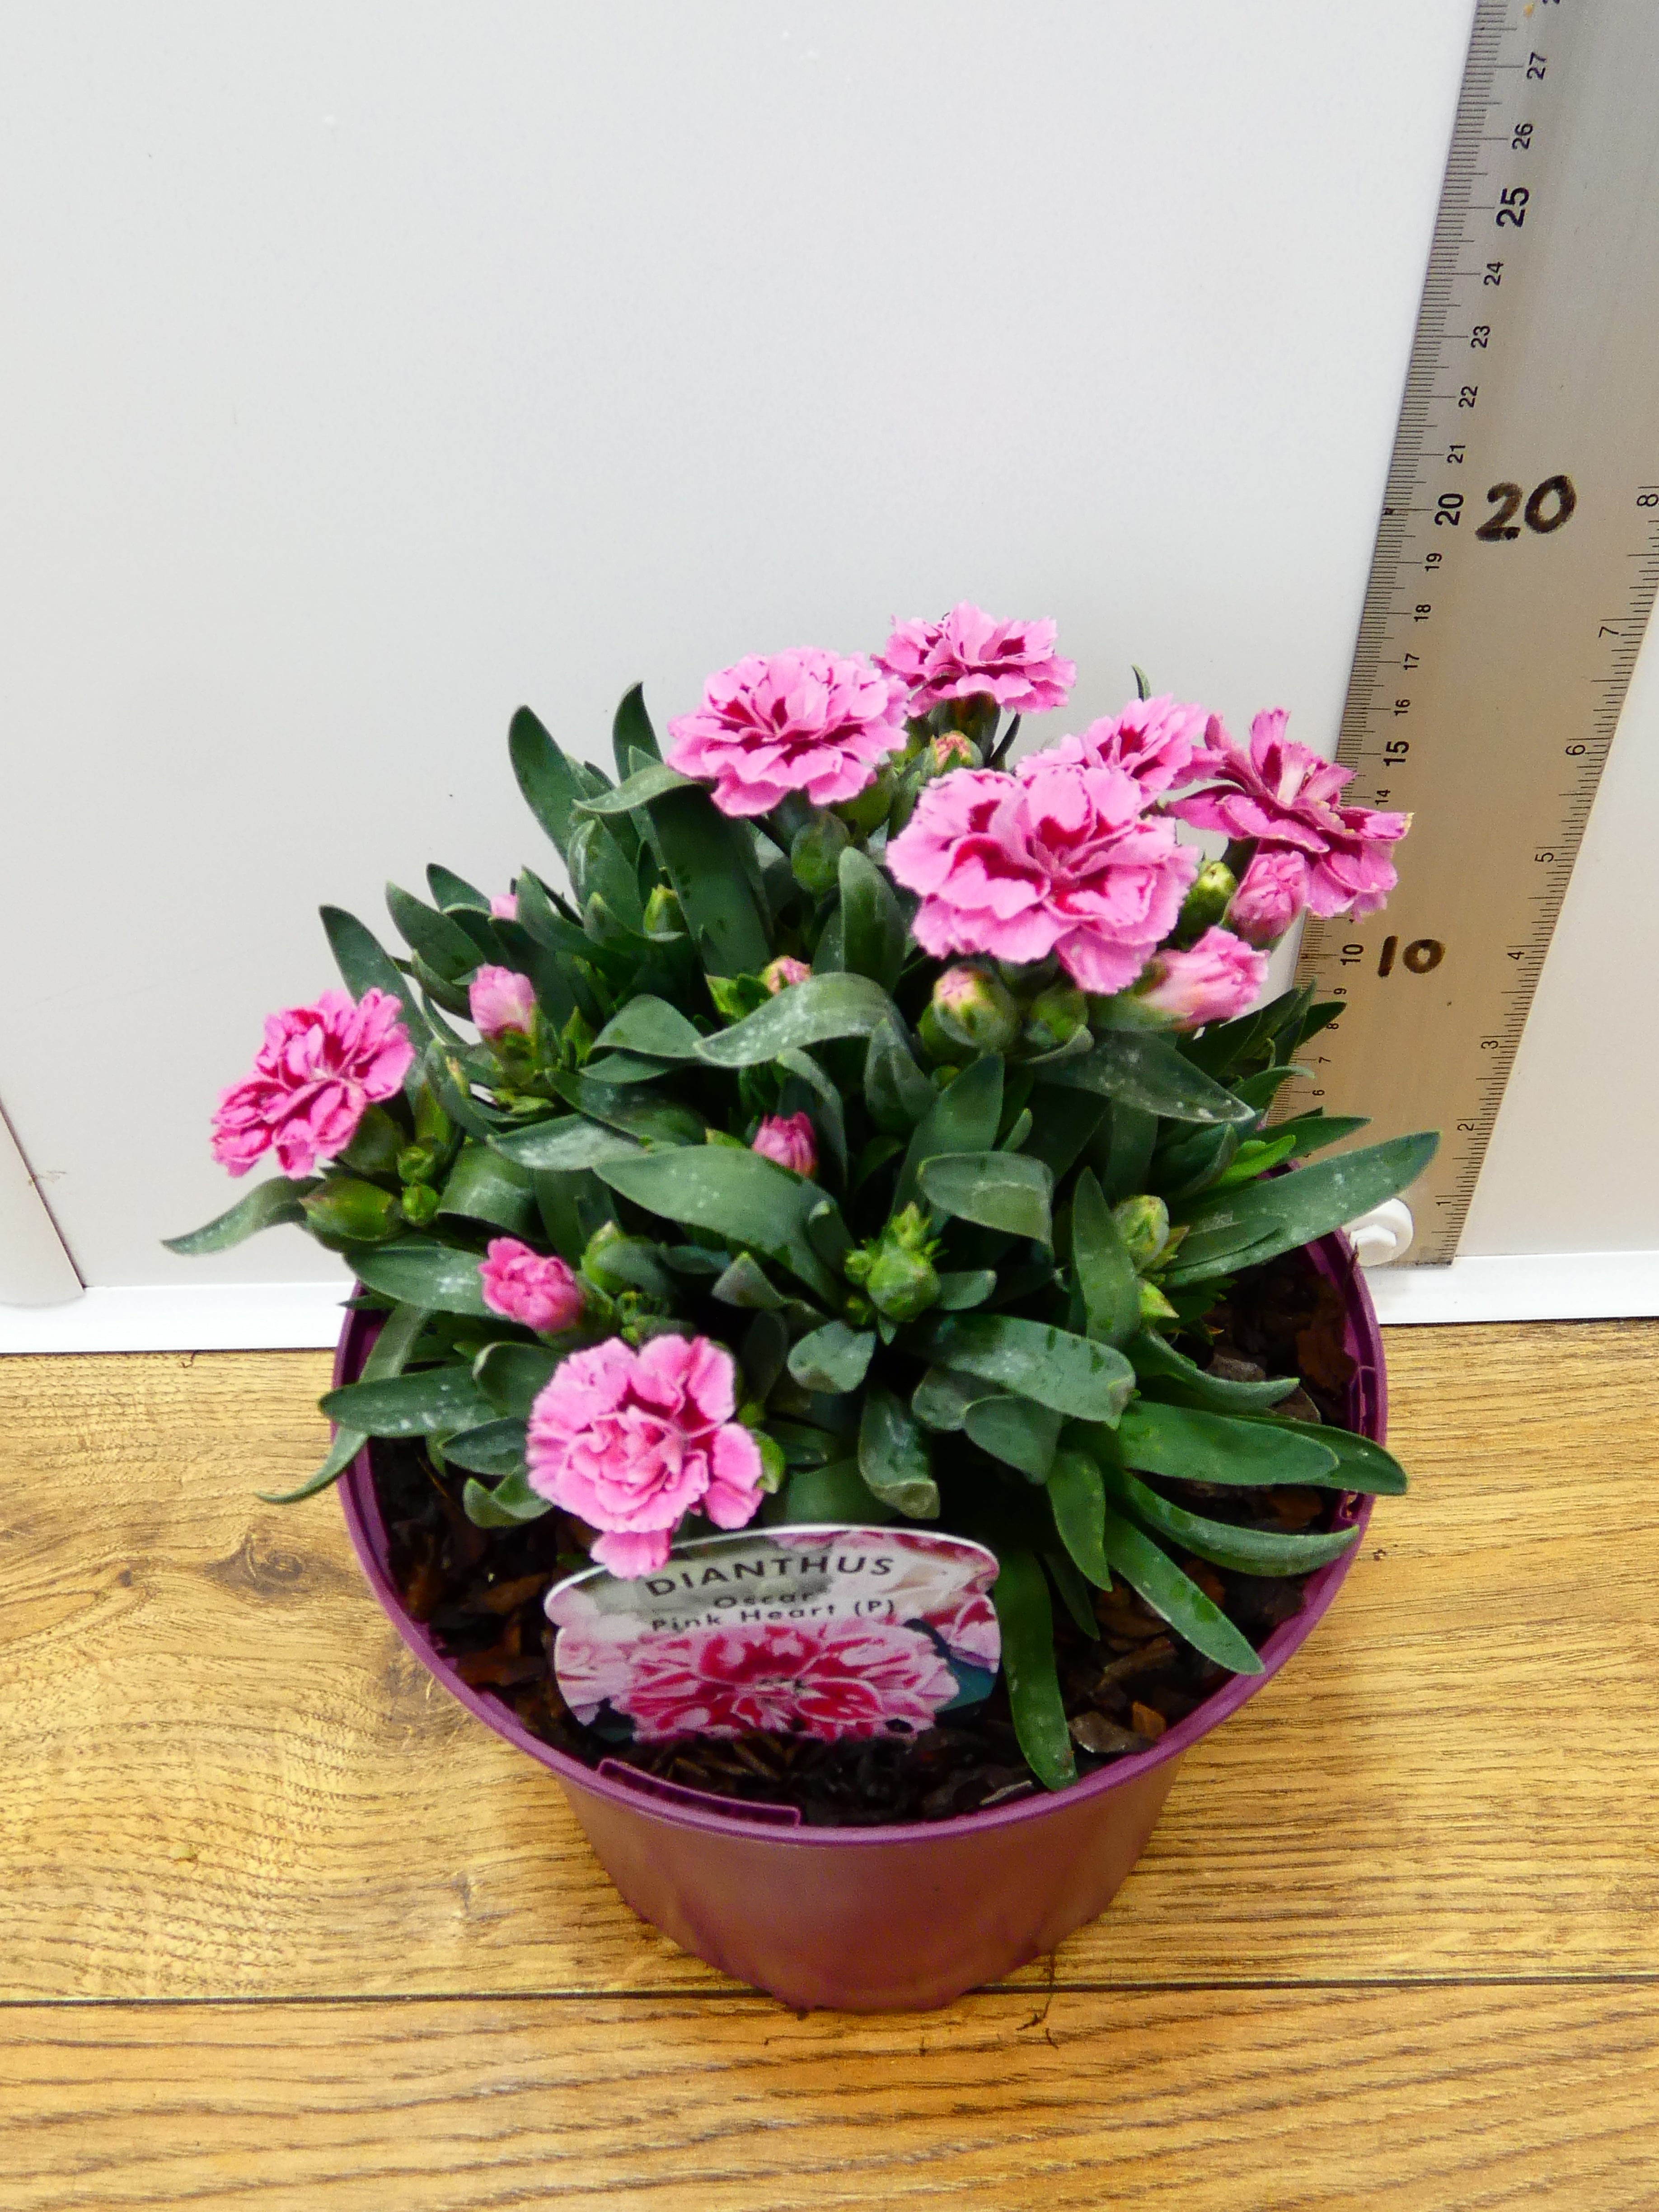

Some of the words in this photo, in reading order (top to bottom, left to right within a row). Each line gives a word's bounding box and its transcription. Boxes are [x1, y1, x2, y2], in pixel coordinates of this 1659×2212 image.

[1527, 52, 1547, 80] 27
[1511, 122, 1533, 150] 26
[1495, 187, 1530, 227] 25
[1484, 261, 1503, 286] 24
[1471, 326, 1490, 348] 23
[1458, 385, 1478, 408] 22
[1447, 445, 1465, 464] 21
[1434, 493, 1464, 525] 20
[1475, 474, 1577, 542] 20
[1636, 493, 1659, 507] 8
[1425, 553, 1442, 571] 19
[1414, 604, 1431, 622] 18
[1599, 626, 1619, 638] 7
[1403, 653, 1420, 670] 17
[1393, 698, 1411, 716] 16
[1383, 740, 1410, 766] 15
[1565, 744, 1585, 756] 6
[1375, 789, 1390, 805] 14
[1534, 852, 1554, 862] 5
[1340, 943, 1364, 965] 10
[1378, 935, 1445, 977] 10
[1507, 950, 1524, 961] 4
[1333, 987, 1347, 995] 9
[1481, 1040, 1499, 1050] 3
[1458, 1123, 1475, 1131] 2
[645, 1556, 893, 1596] DIANTHUS
[714, 1592, 815, 1609] Oscar
[653, 1614, 720, 1632] Pink
[740, 1604, 835, 1623] Heart
[854, 1599, 894, 1616] (P)
